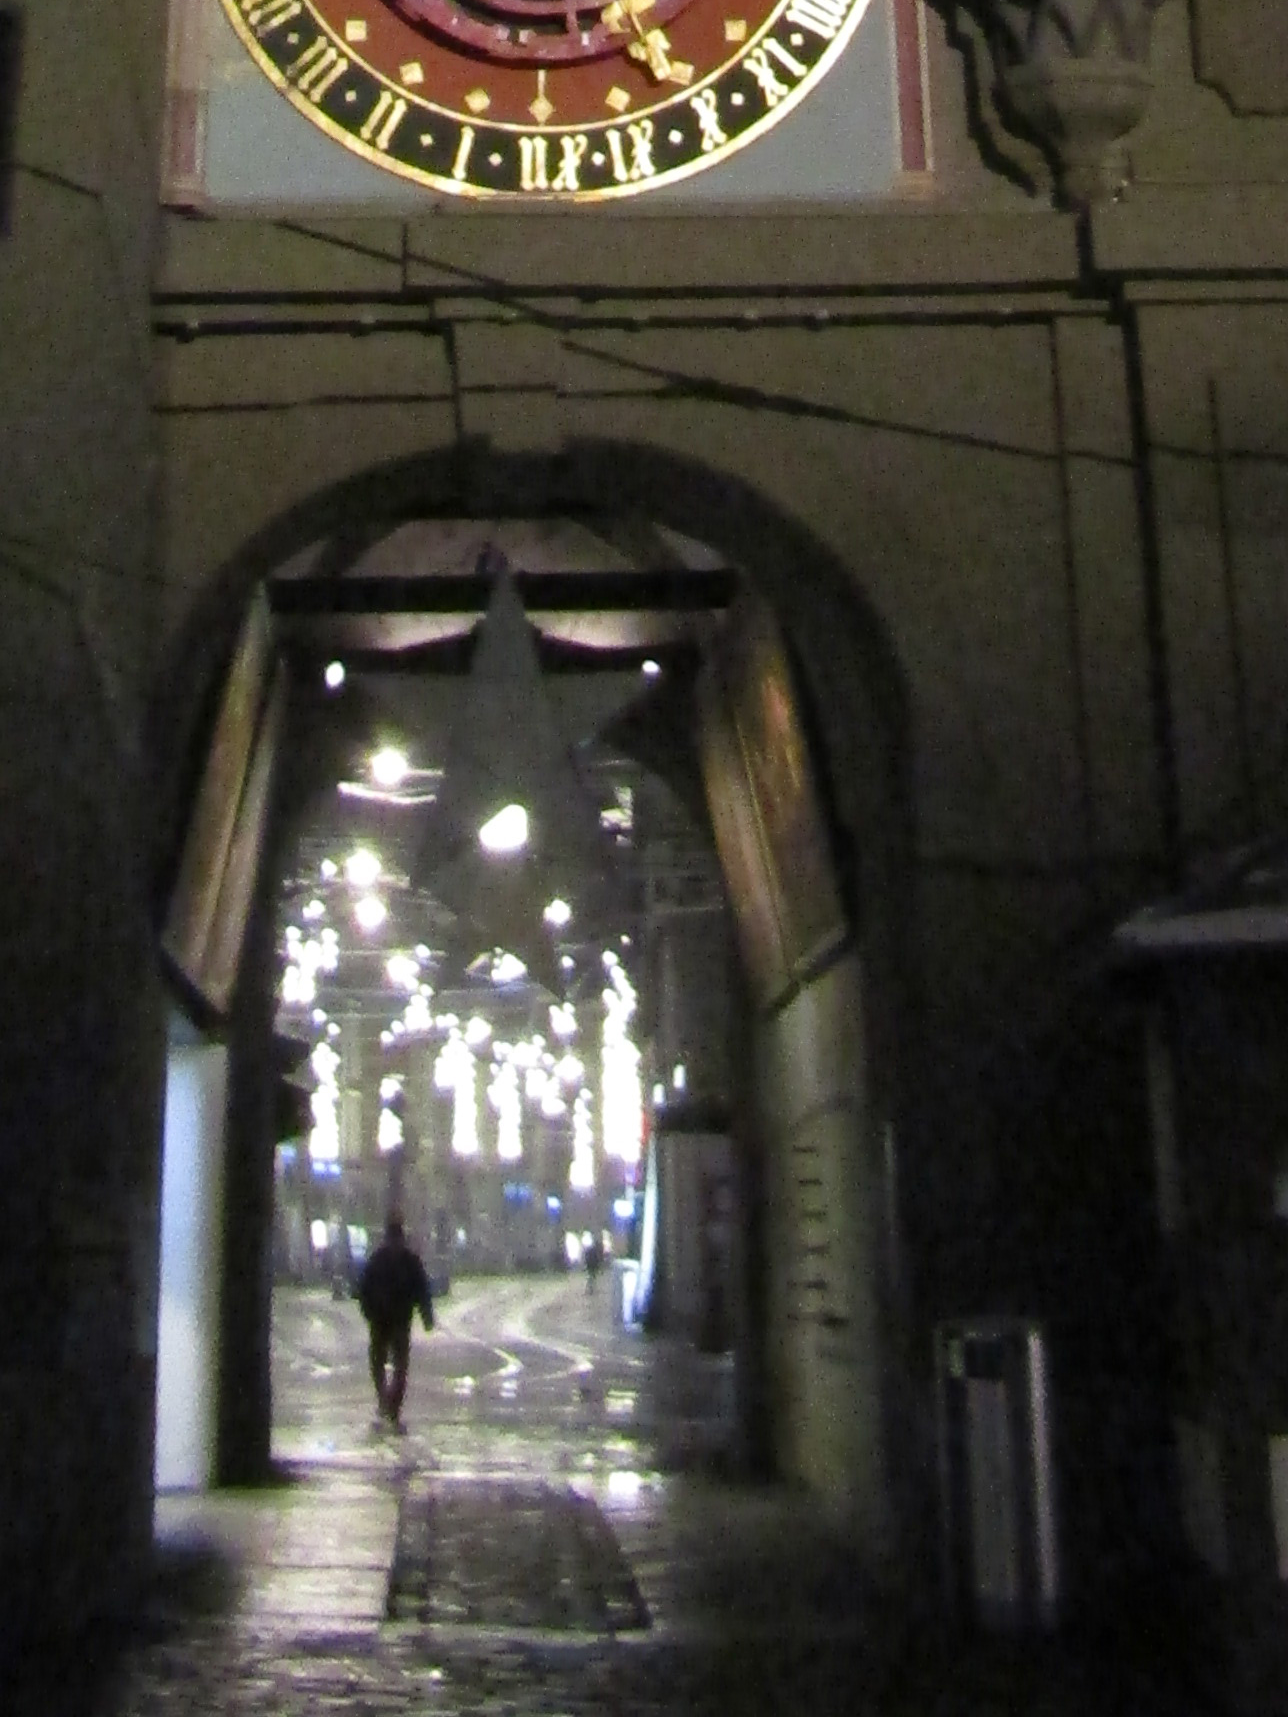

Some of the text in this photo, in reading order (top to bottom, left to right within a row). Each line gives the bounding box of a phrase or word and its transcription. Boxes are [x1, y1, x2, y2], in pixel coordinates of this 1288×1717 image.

[285, 35, 349, 104] III
[743, 37, 808, 107] IX
[359, 90, 407, 151] II
[606, 119, 656, 183] XI
[690, 88, 728, 152] X
[451, 124, 476, 181] I
[518, 132, 588, 191] XII
